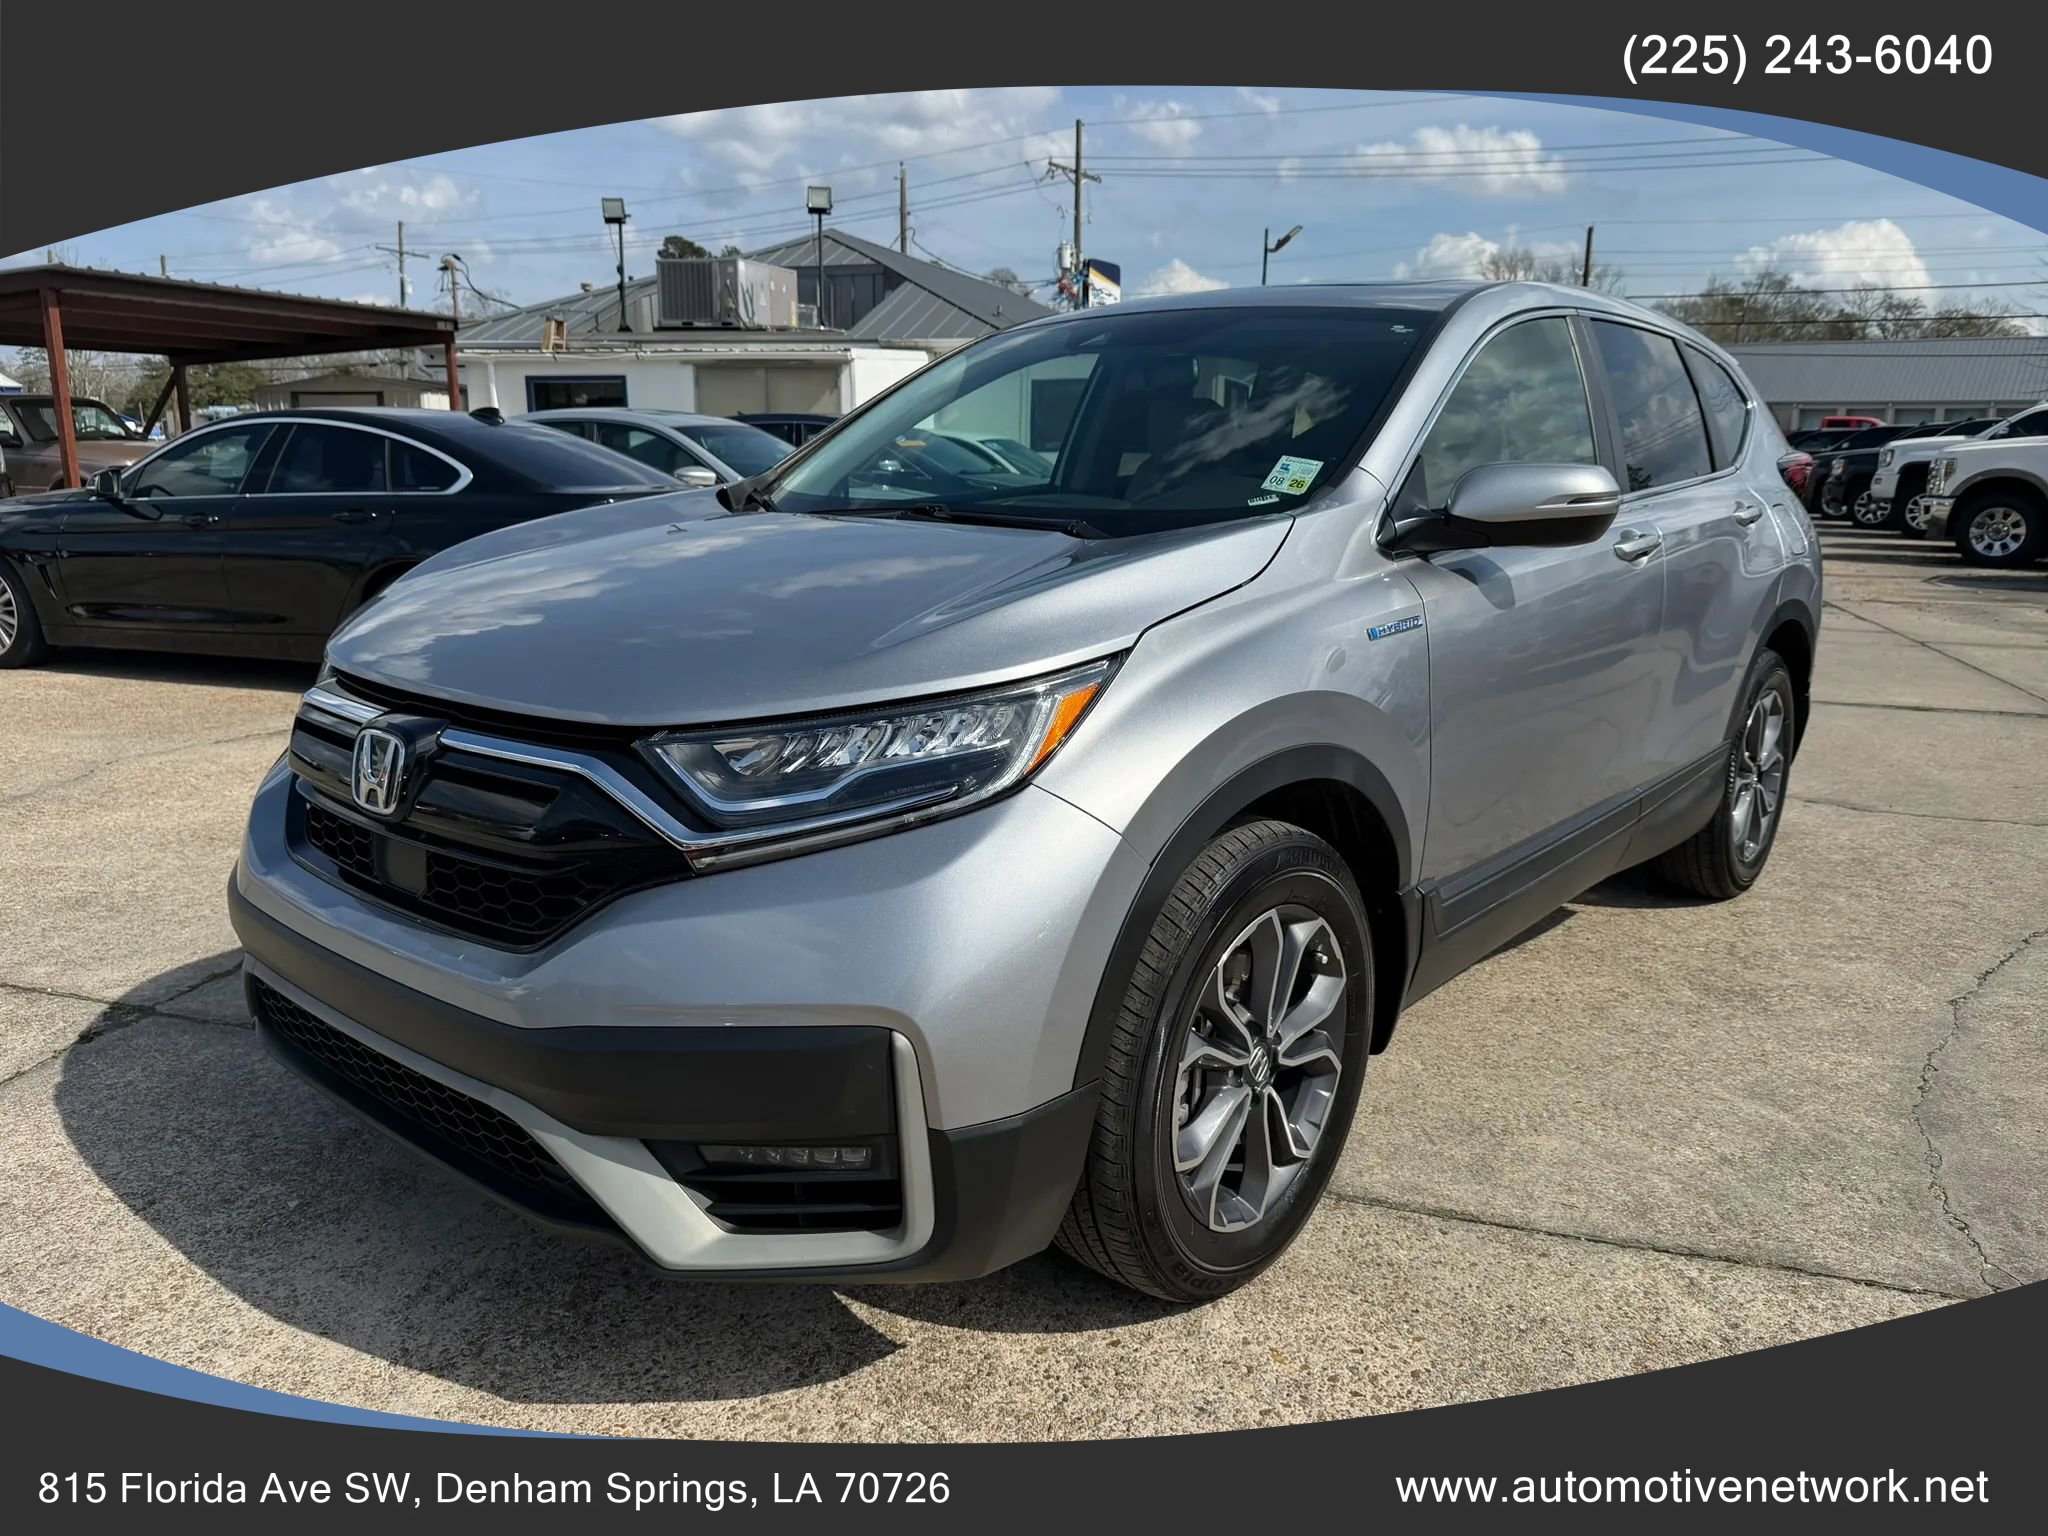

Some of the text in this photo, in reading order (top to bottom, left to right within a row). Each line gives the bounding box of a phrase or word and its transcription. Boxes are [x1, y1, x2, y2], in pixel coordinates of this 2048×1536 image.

[1269, 475, 1285, 486] 08
[1289, 479, 1305, 489] 26
[1377, 616, 1423, 638] HYBRID
